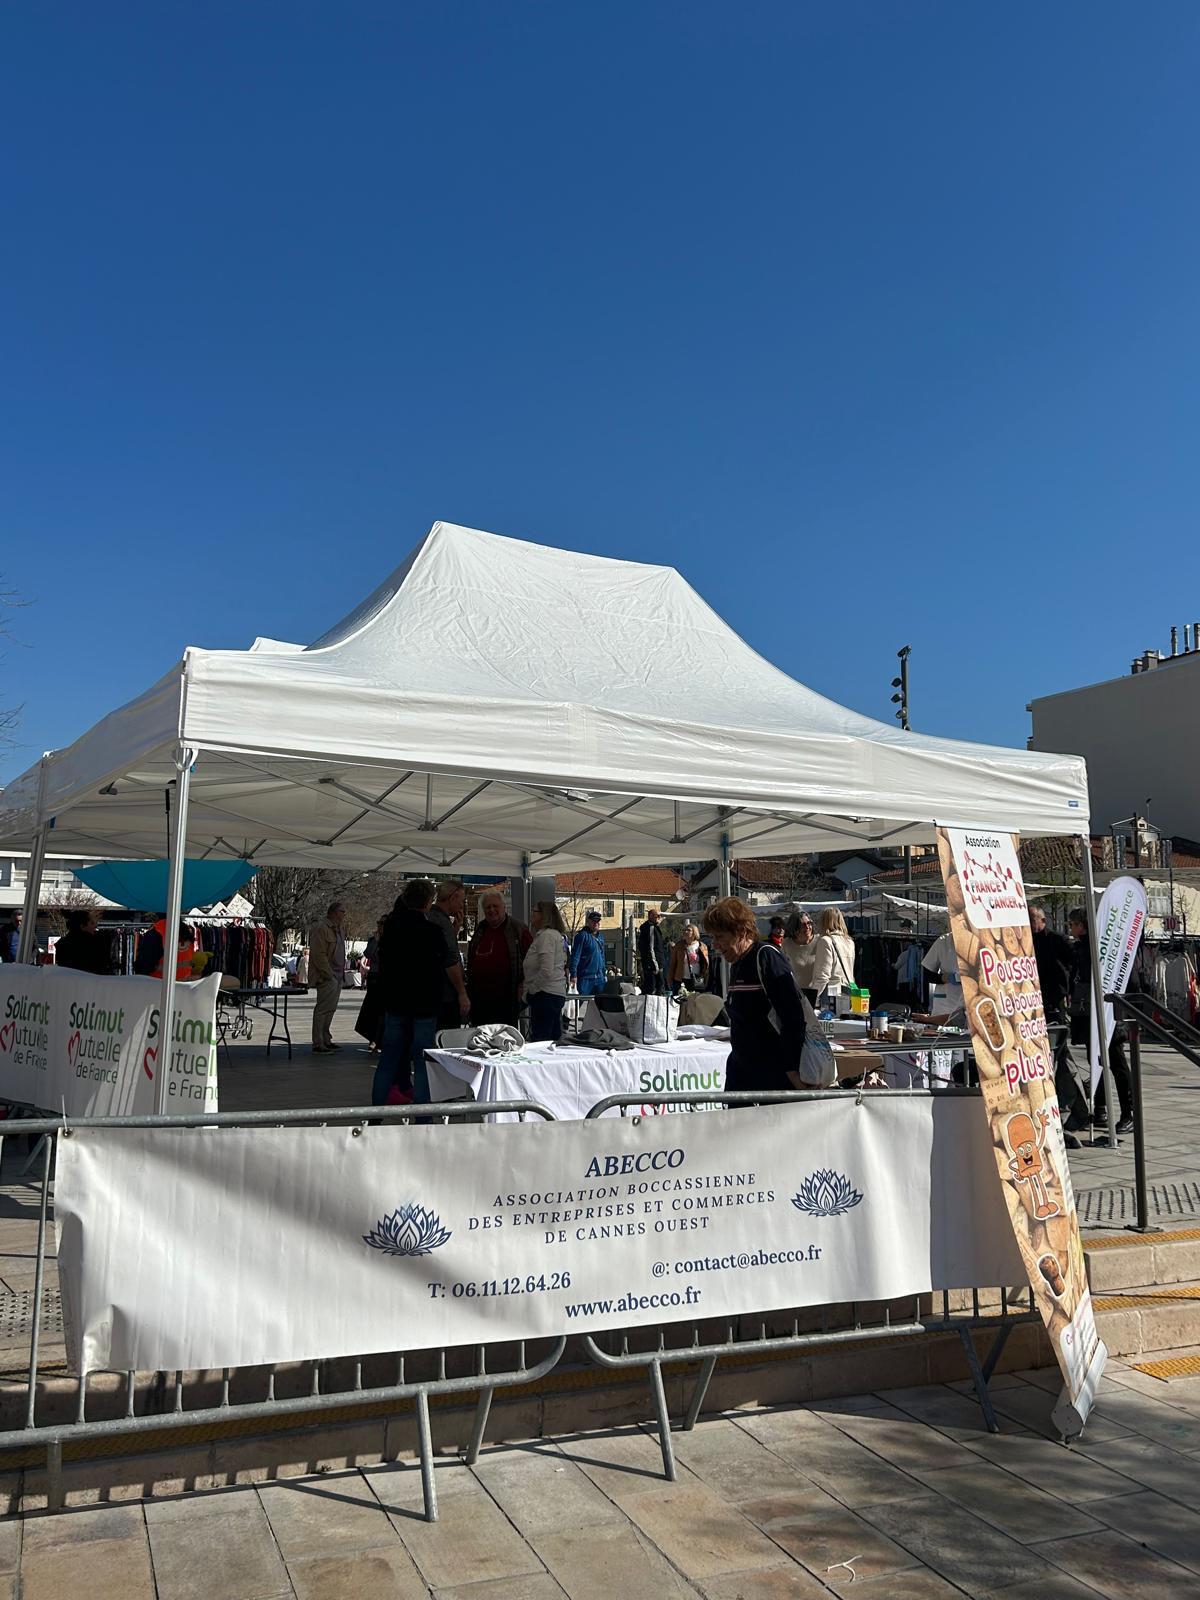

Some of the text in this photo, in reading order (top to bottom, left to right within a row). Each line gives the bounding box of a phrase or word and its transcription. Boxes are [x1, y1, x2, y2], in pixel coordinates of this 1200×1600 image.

[965, 835, 1001, 849] Association
[971, 881, 1002, 893] FRANCE
[989, 896, 1019, 909] CANCER
[1111, 909, 1144, 994] ÉNÉRATIONS SOLIDAIRES
[1102, 948, 1119, 994] utuelle
[5, 994, 50, 1026] Solimut
[69, 1002, 125, 1034] Solimut
[67, 1030, 121, 1066] Mutuelle
[76, 1062, 88, 1078] de
[639, 1068, 722, 1093] Solimut
[1005, 1048, 1046, 1094] plus
[584, 1148, 685, 1178] ABECCO
[493, 1173, 757, 1207] ASSOCIATION BOCCASSIENNE
[469, 1190, 776, 1230] DES ENTREPRISES ET COMMERCES
[544, 1216, 711, 1244] DE CANNES OUEST
[652, 1244, 822, 1278] @: contact@abecco.fr
[427, 1271, 572, 1298] T: 06.11.12.64.26
[564, 1285, 702, 1318] www.abecco.fr
